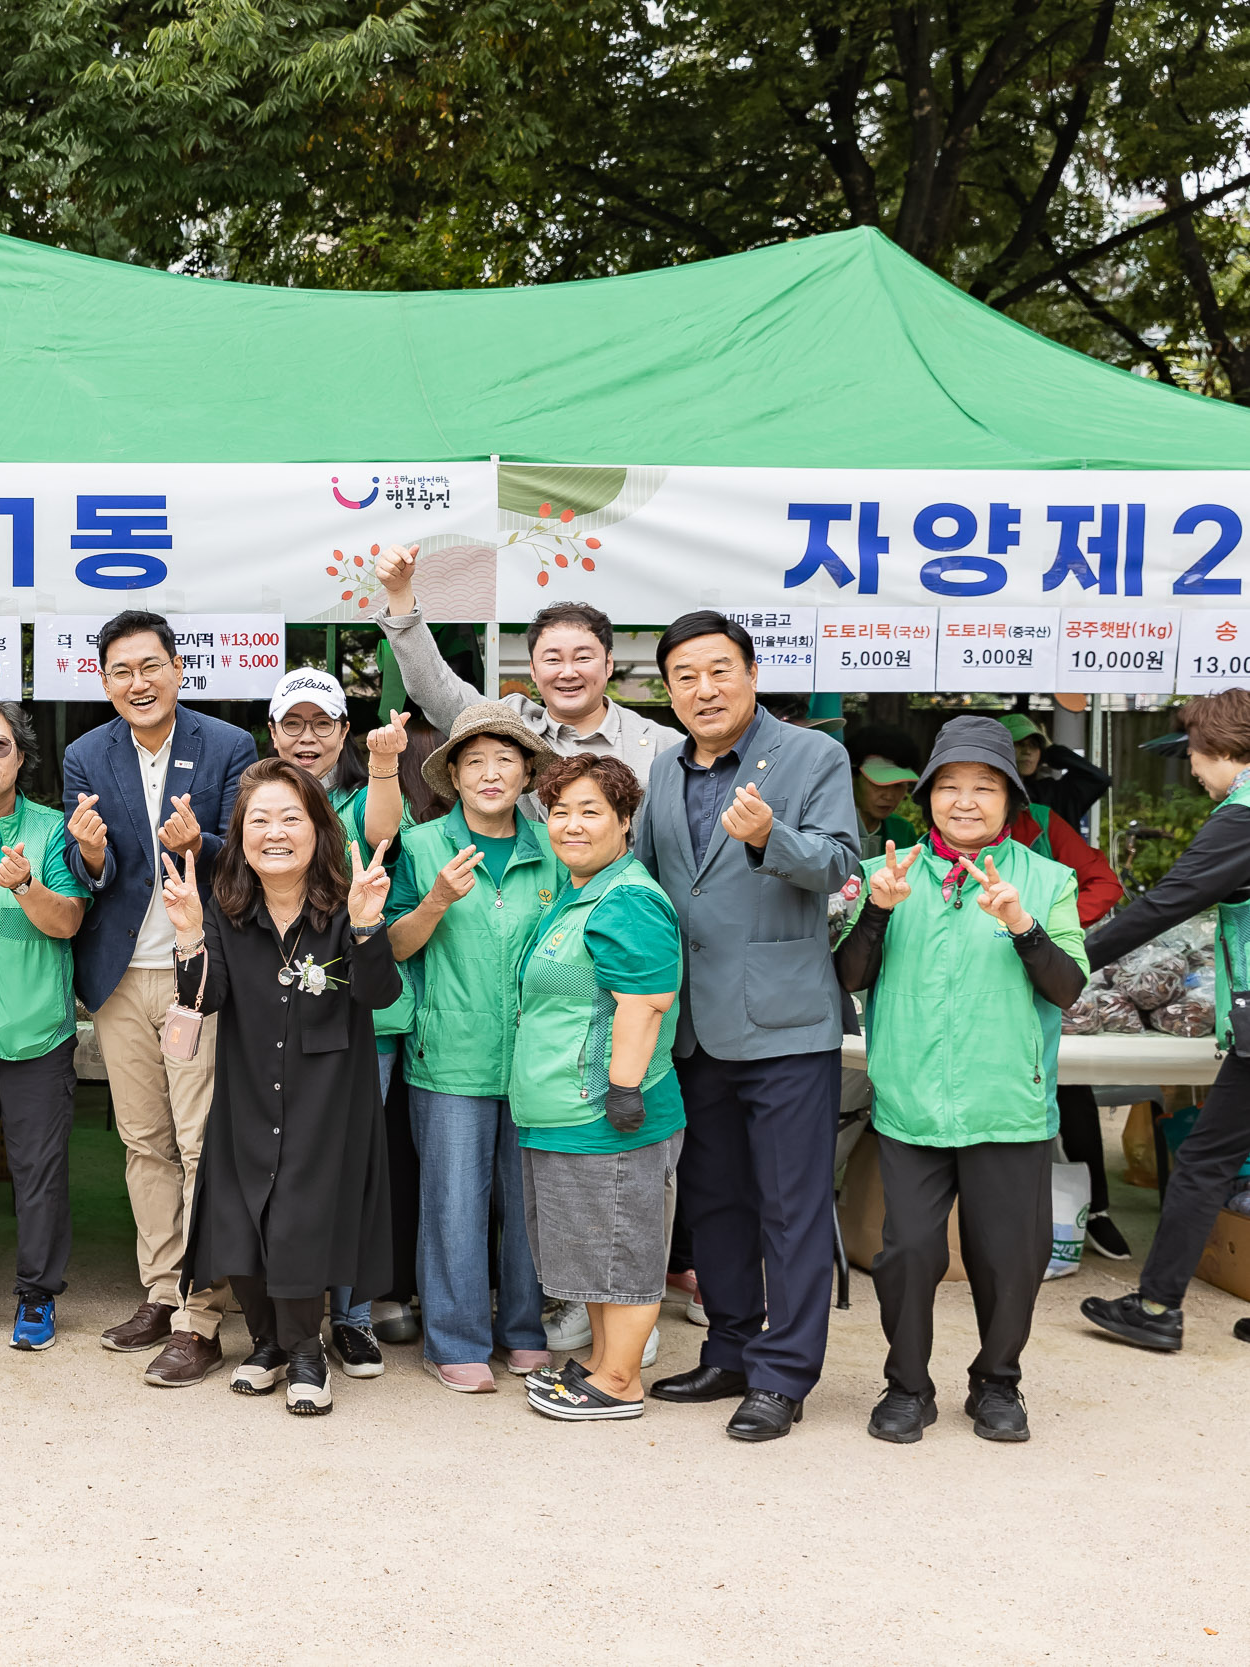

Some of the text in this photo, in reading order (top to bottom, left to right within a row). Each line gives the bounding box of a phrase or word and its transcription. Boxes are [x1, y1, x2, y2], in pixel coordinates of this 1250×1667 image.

[385, 487, 450, 511] 행복광진
[784, 502, 1243, 597] 자양제2
[1065, 621, 1173, 640] 공주햇밤(1kg)
[1215, 620, 1238, 642] 송
[751, 634, 814, 648] 마을부녀회)
[77, 658, 102, 675] 25,
[756, 654, 813, 665] 6-1742-8
[840, 650, 911, 669] 5,000원
[962, 648, 1033, 667] 3,000원
[1071, 650, 1164, 672] 10,000원
[281, 677, 333, 697] Titleist
